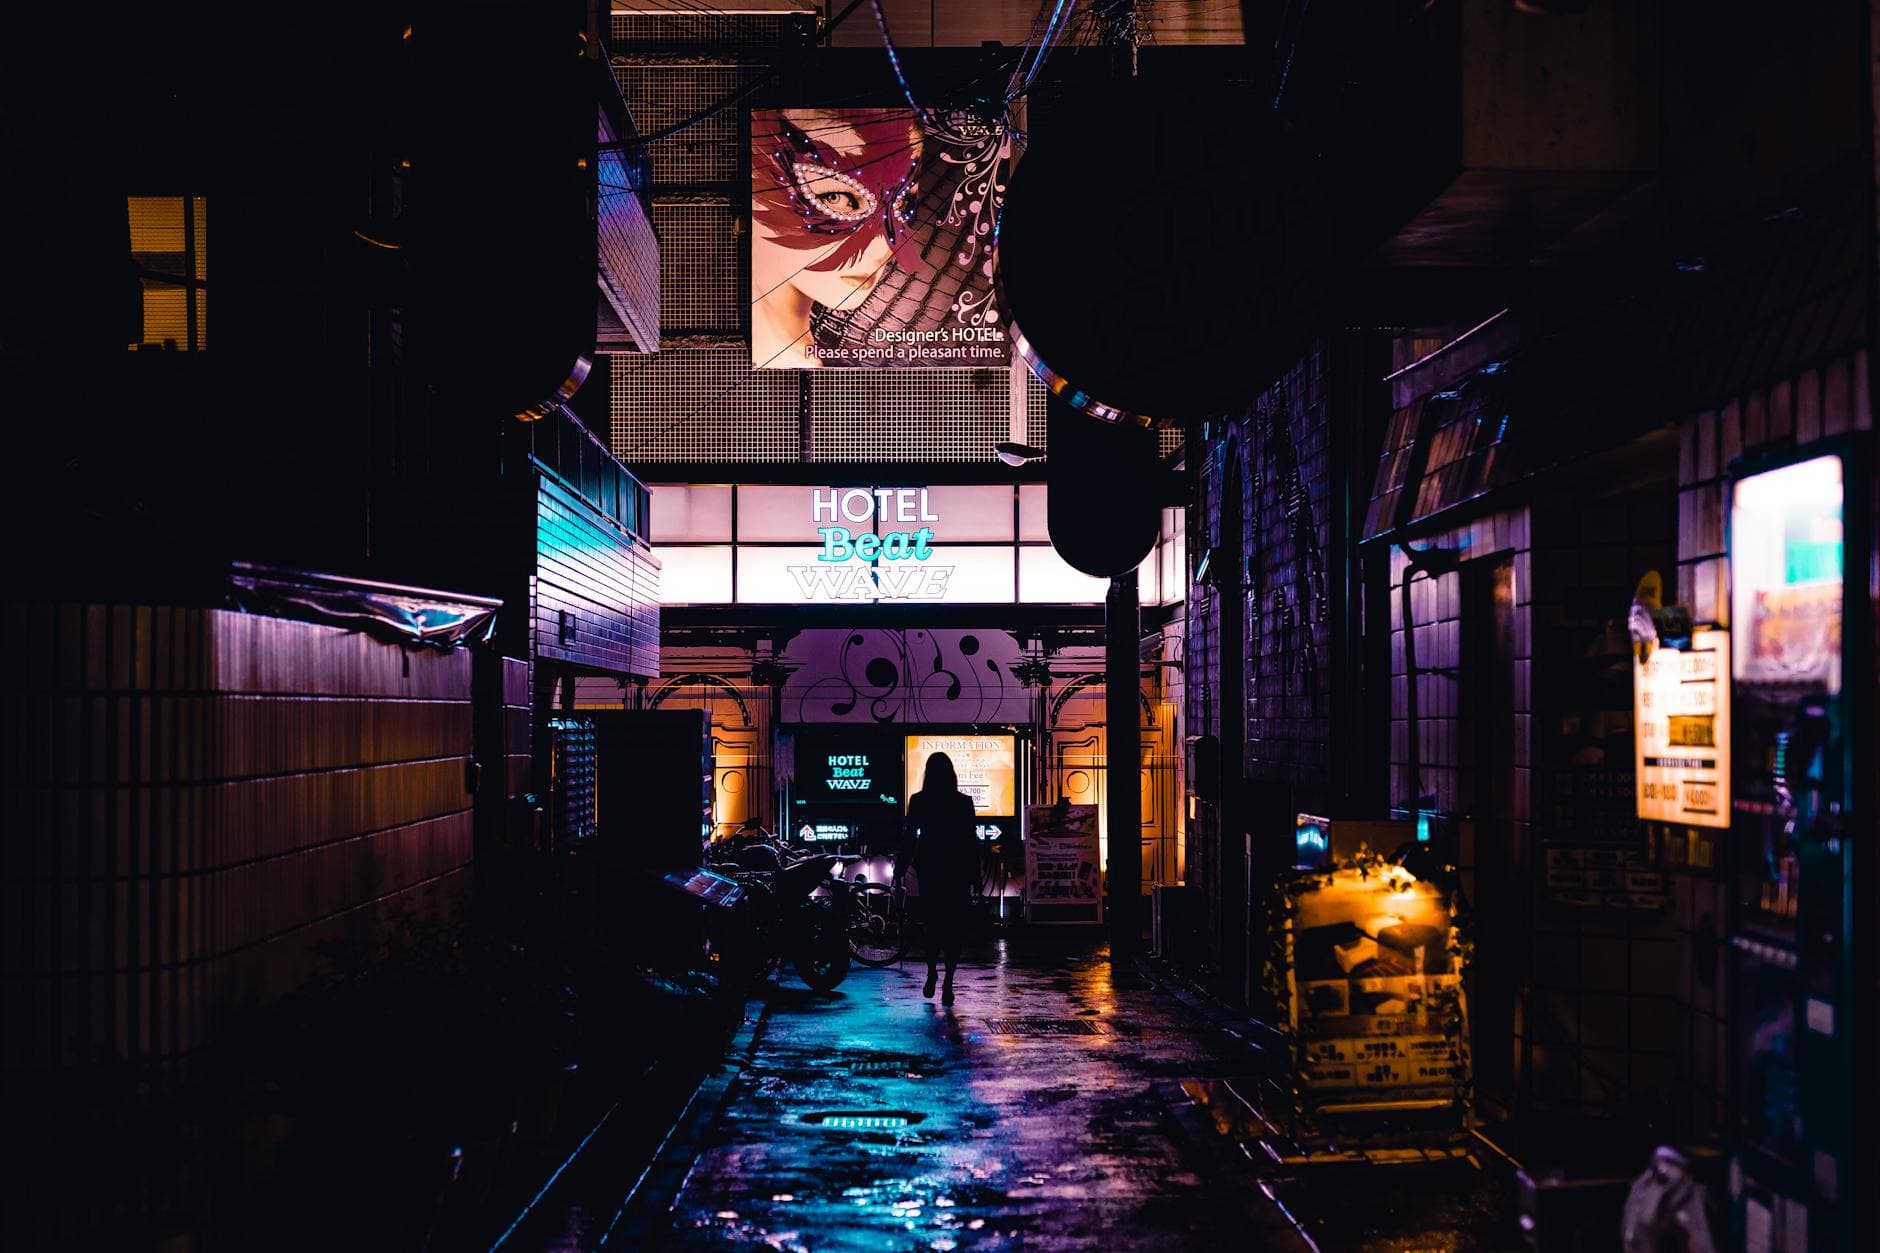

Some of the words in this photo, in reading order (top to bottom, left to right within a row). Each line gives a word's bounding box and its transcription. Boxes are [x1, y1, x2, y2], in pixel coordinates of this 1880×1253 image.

[805, 345, 849, 359] Please
[852, 345, 895, 362] spend
[897, 348, 905, 359] a
[908, 345, 967, 362] pleasant
[970, 345, 1005, 358] time.
[813, 488, 940, 523] HOTEL
[817, 526, 935, 562] Beat
[786, 565, 956, 600] WAVE
[922, 741, 1001, 751] INFORMATION
[827, 755, 870, 766] HOTEL
[832, 767, 865, 778] Beat
[968, 770, 984, 779] Fee
[825, 779, 872, 790] WAVE
